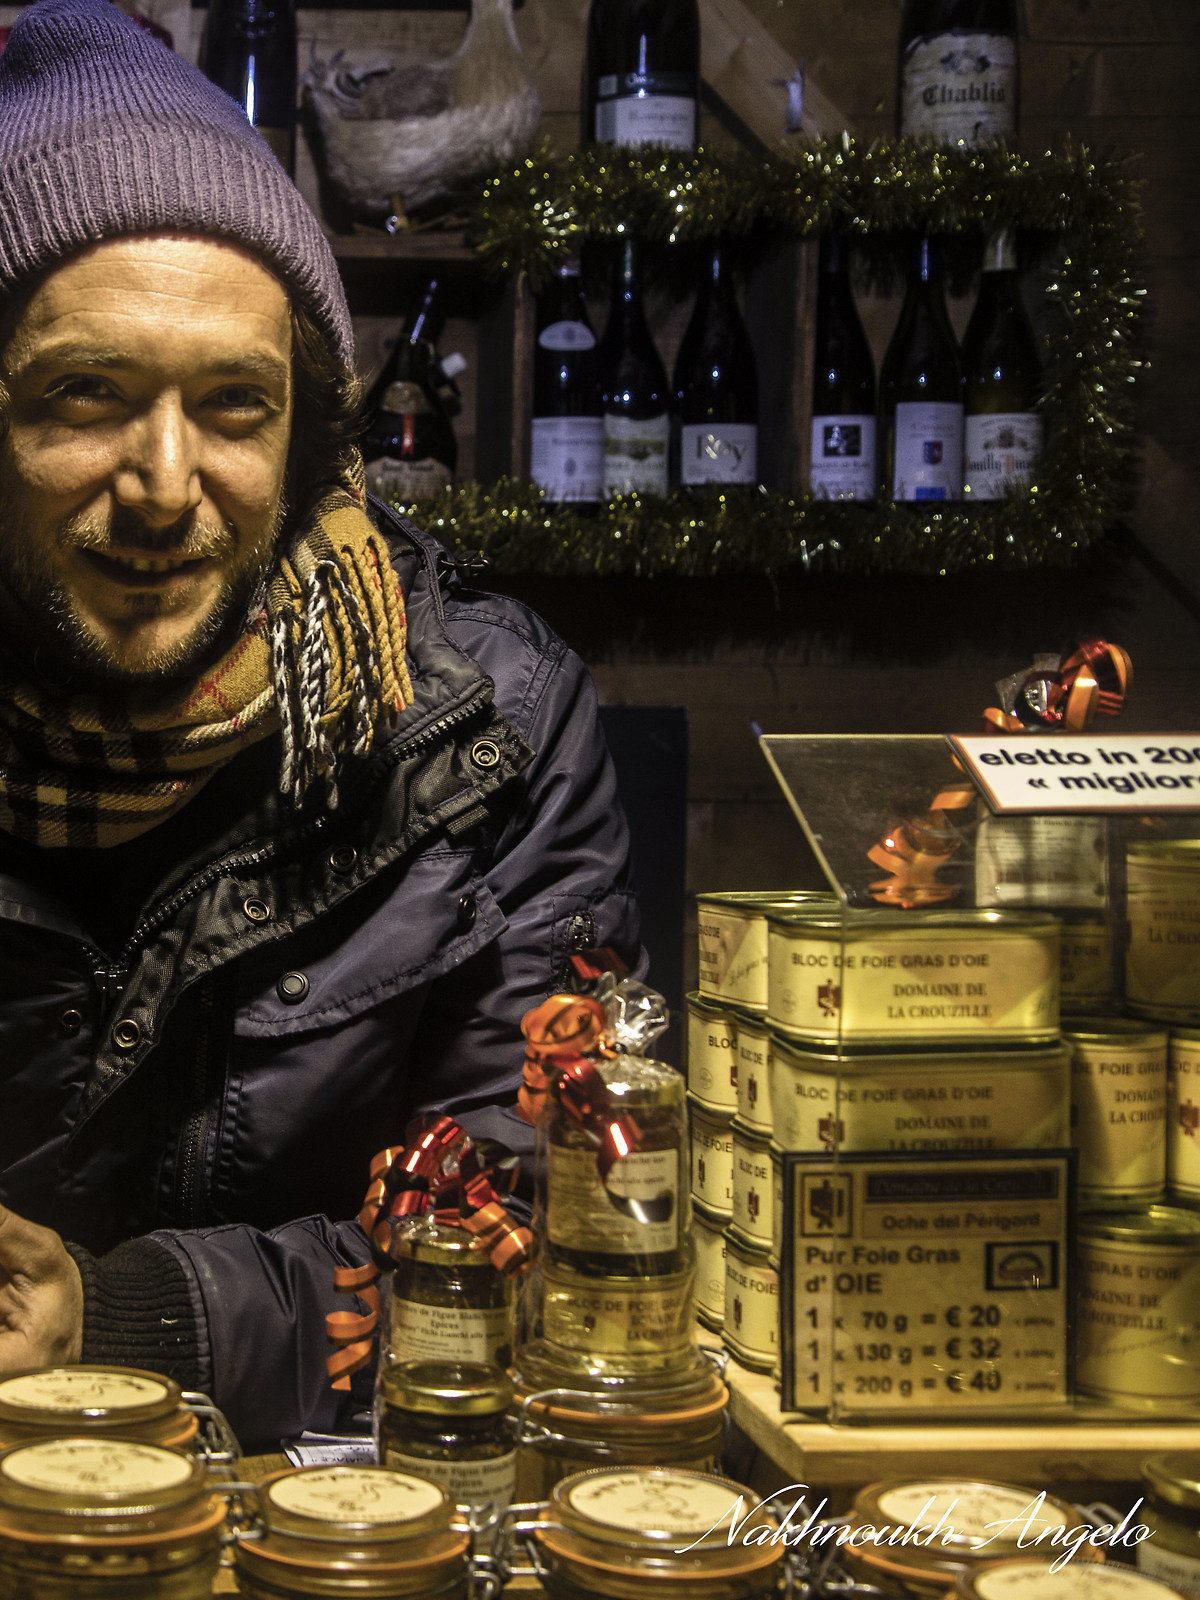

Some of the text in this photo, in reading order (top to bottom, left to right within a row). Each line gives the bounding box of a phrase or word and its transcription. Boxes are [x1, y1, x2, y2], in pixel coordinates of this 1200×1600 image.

[922, 82, 1006, 106] Chablis
[979, 748, 1092, 765] eletto
[1097, 748, 1139, 765] in
[1058, 771, 1200, 794] miglior
[793, 952, 990, 969] BLOC DE FOIE GRAS D'OIE
[893, 982, 987, 997] DOMAINE DE
[888, 1004, 992, 1019] LA CROUZILLE
[1099, 1061, 1131, 1076] FOIE
[796, 1083, 993, 1102] BLOC DE FOIE GRAS D'OIE
[895, 1115, 990, 1131] DOMAINE DE
[711, 1138, 733, 1153] FOIE
[755, 1165, 767, 1180] DE
[881, 1214, 928, 1231] Oche
[933, 1212, 961, 1230] del
[805, 1244, 962, 1265] Pur Foie Gras
[750, 1276, 778, 1295] FOIE
[836, 1272, 883, 1294] OIE
[605, 1301, 625, 1312] DE
[806, 1306, 819, 1330] 1
[861, 1310, 888, 1330] 70
[893, 1314, 908, 1334] g
[969, 1304, 1001, 1328] 20
[806, 1339, 819, 1362] 1
[855, 1343, 892, 1363] 130
[898, 1346, 913, 1366] g
[969, 1336, 1002, 1360] 32
[807, 1371, 820, 1394] 1
[855, 1375, 893, 1394] 200
[899, 1379, 914, 1398] g
[969, 1369, 1002, 1393] 40
